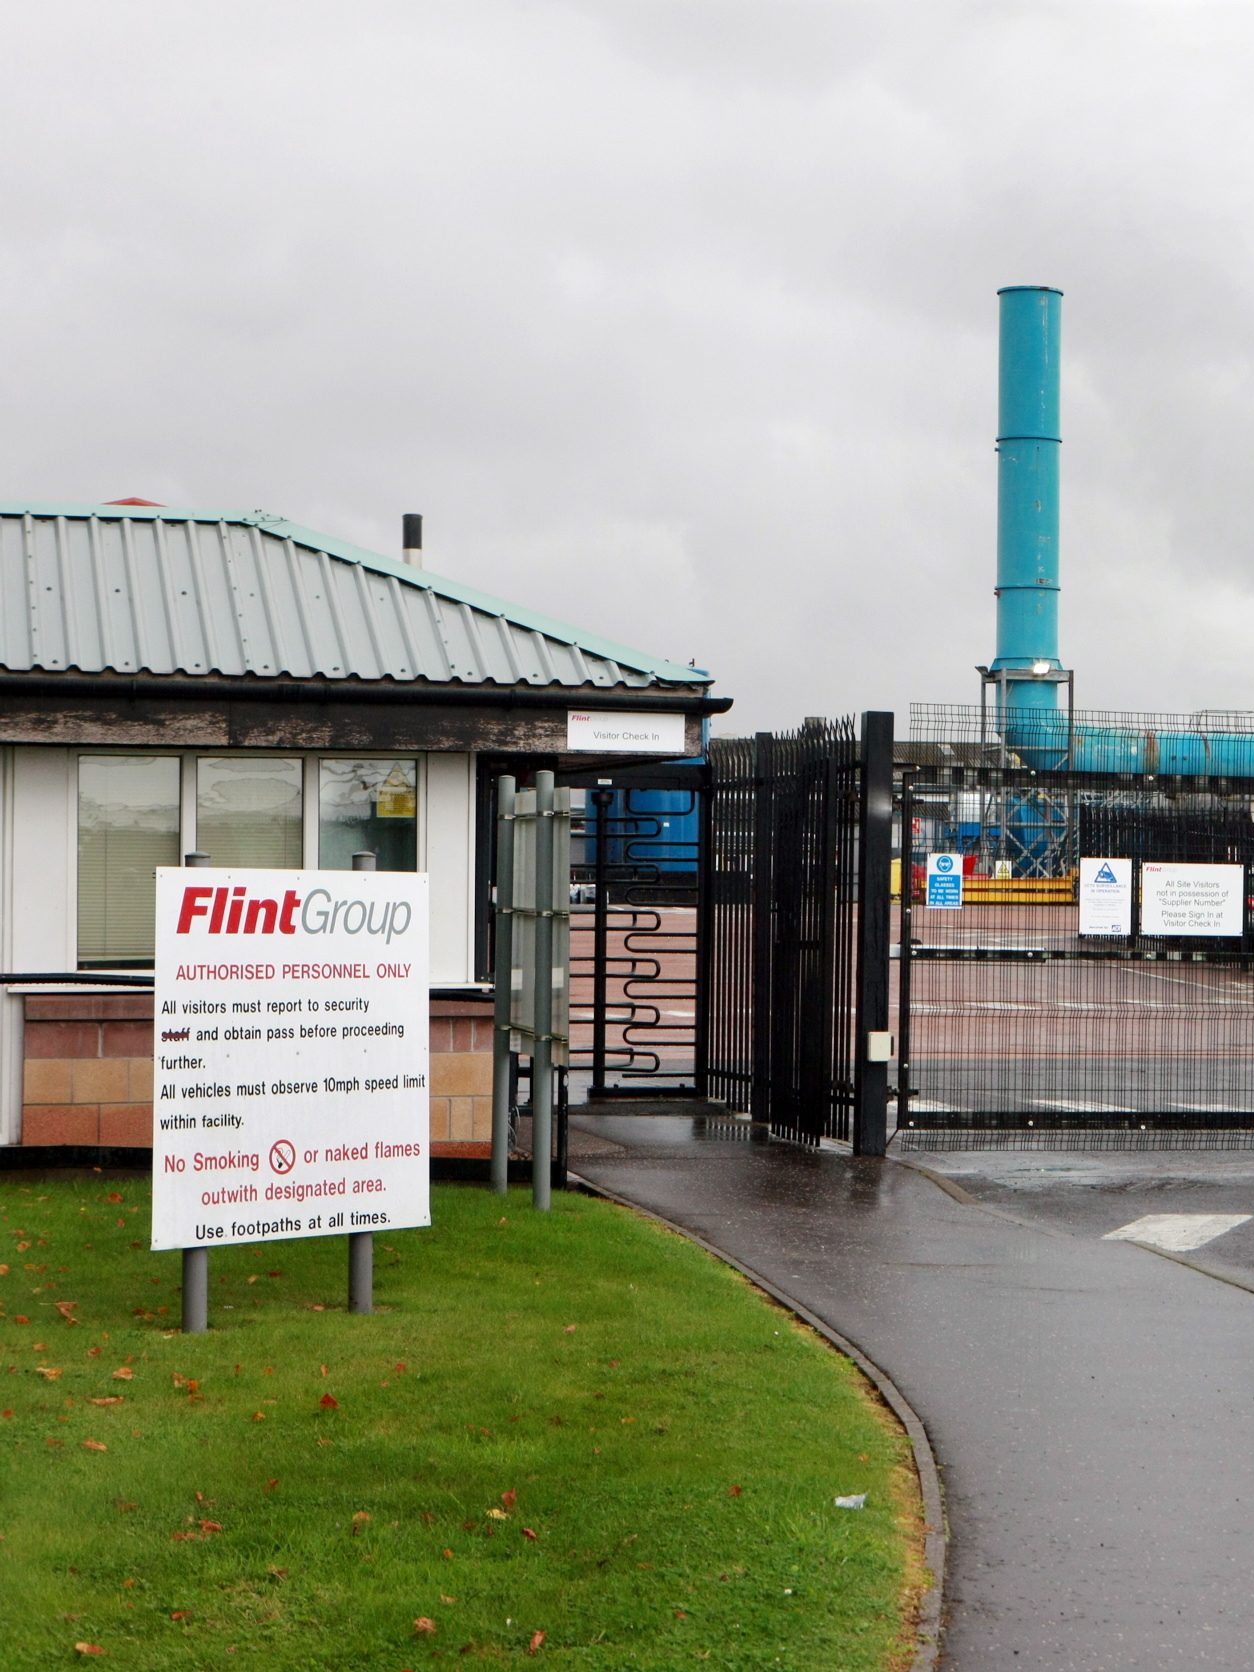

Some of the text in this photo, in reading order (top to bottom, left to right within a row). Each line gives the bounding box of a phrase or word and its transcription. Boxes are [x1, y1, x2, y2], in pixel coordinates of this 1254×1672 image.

[593, 731, 620, 740] Visitor
[622, 732, 649, 740] Check
[1165, 880, 1220, 889] All Site Visitors
[1159, 898, 1226, 907] "Supplier Number"
[1179, 890, 1219, 899] possession
[1221, 890, 1229, 898] of
[1161, 910, 1223, 920] Please Sign In at
[1188, 920, 1212, 928] Check
[176, 964, 412, 981] AUTHORISED PERSONNEL ONLY
[161, 998, 370, 1015] All visitors must report to security
[196, 1027, 219, 1041] and
[224, 1026, 261, 1040] obtain
[267, 1028, 295, 1042] pass
[300, 1024, 337, 1038] before
[342, 1023, 405, 1039] proceeding
[160, 1055, 206, 1070] further.
[160, 1074, 426, 1099] All vehicles must observe 10mph speed limit
[160, 1114, 244, 1130] within facility.
[303, 1141, 420, 1164] or naked flames
[164, 1151, 260, 1173] No Smoking
[201, 1177, 387, 1205] outwith designated area.
[195, 1211, 391, 1240] Use footpaths at all times.
